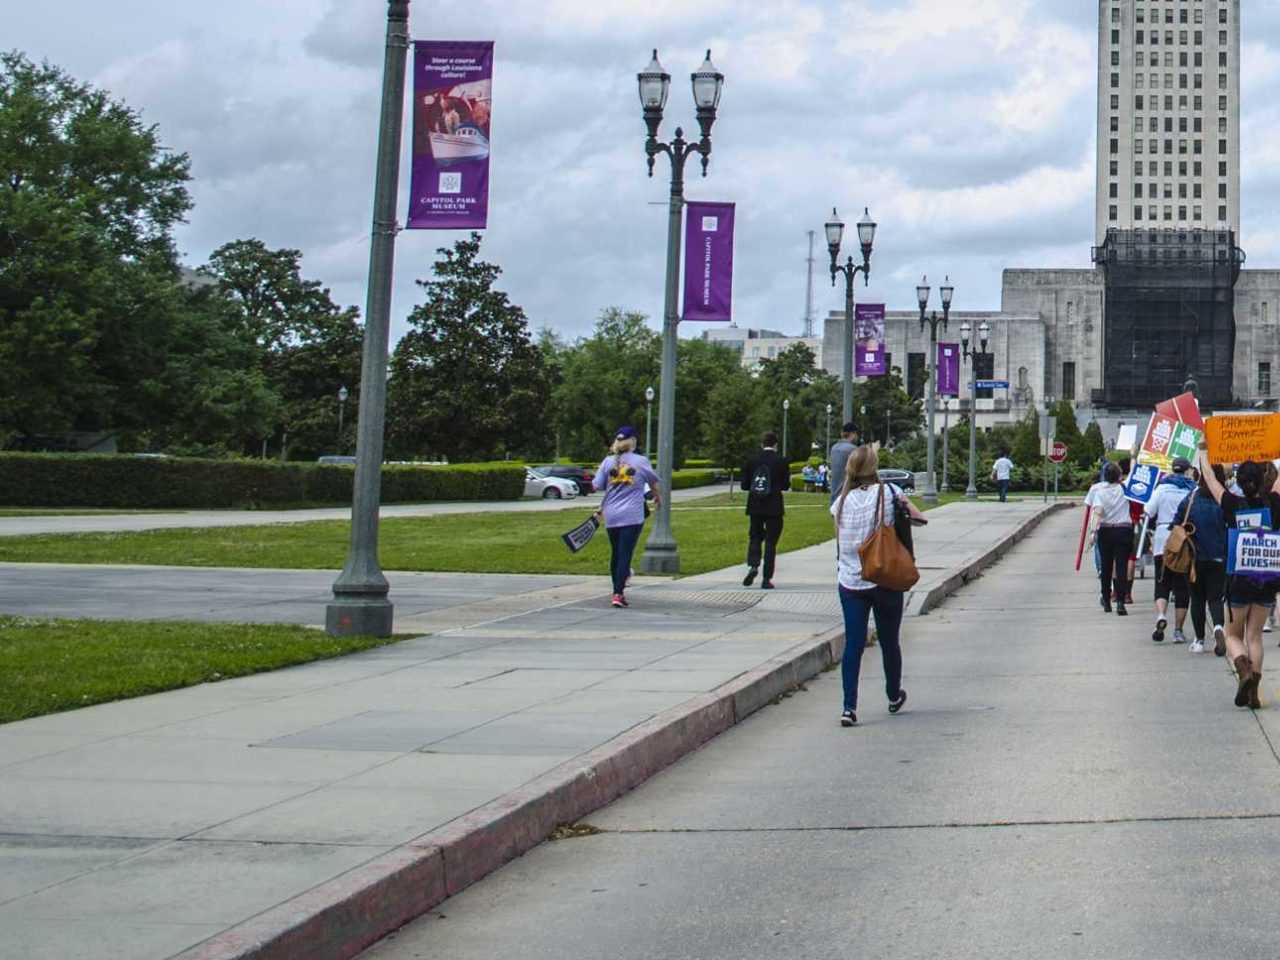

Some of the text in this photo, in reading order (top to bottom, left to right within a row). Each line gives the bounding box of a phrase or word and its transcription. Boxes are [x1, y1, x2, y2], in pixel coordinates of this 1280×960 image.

[1242, 538, 1278, 548] MARCH
[1242, 548, 1261, 557] FOR
[1241, 558, 1269, 568] LIVES
